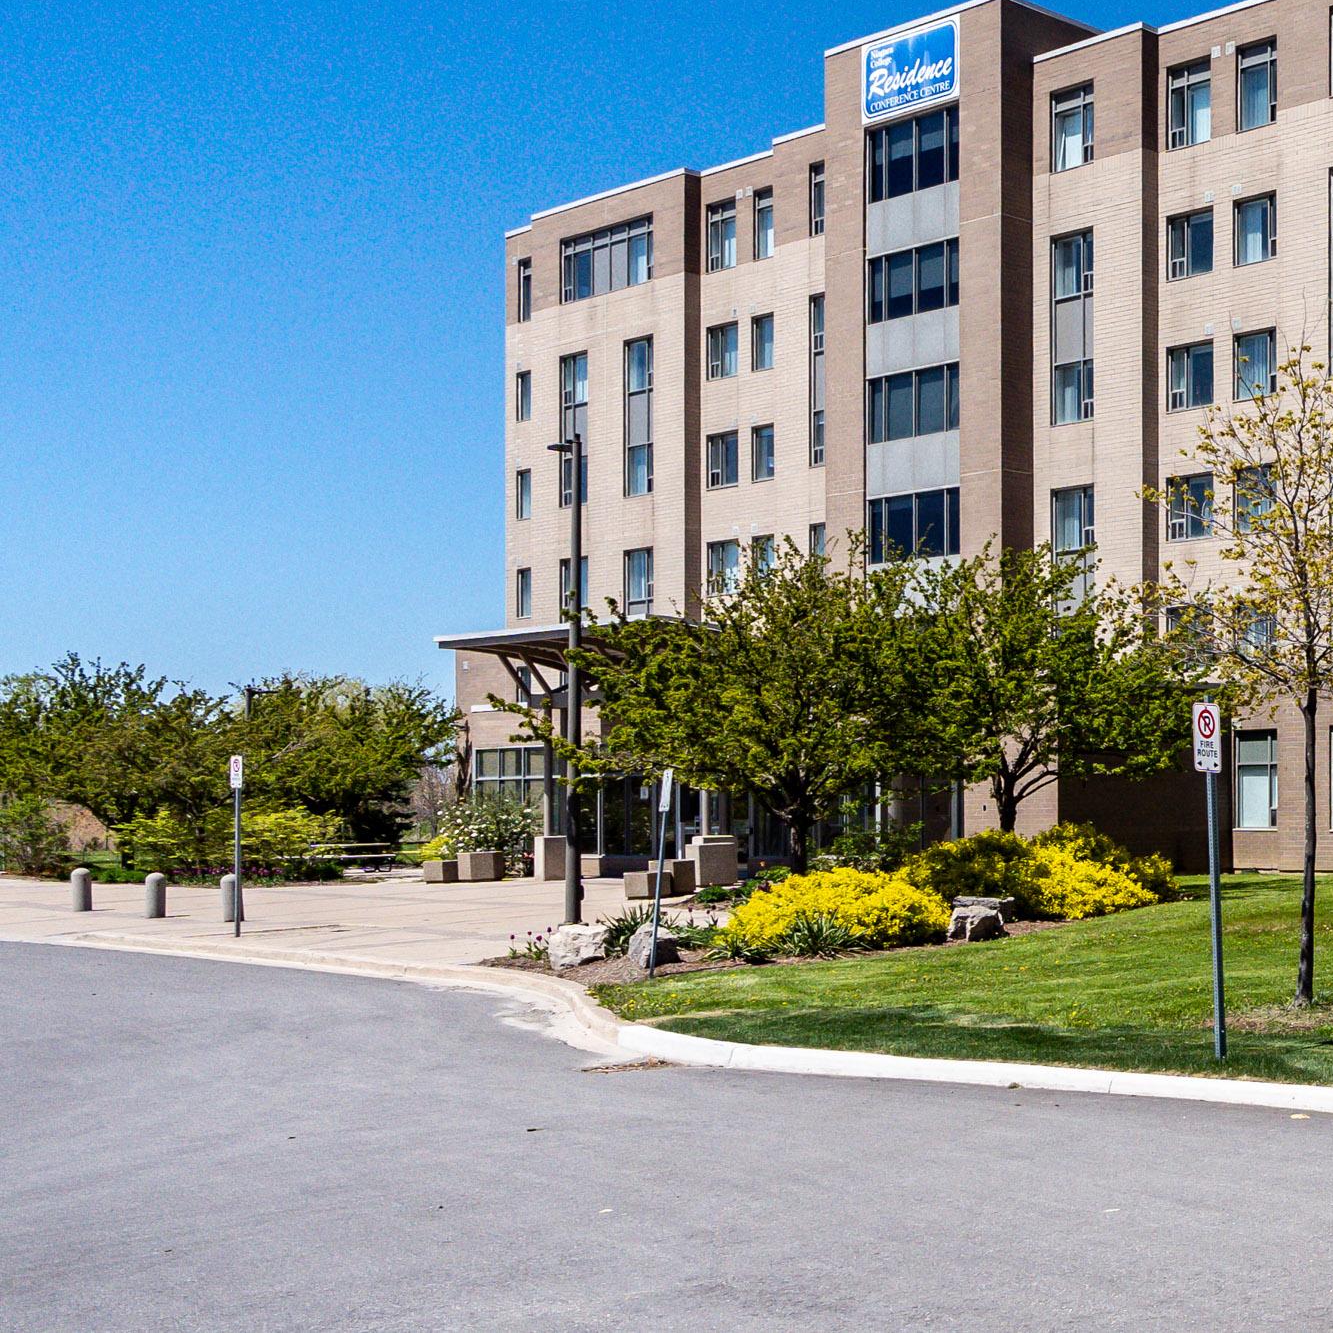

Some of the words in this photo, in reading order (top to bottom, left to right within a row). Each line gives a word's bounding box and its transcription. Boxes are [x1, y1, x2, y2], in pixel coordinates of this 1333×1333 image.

[868, 57, 953, 100] Residence
[870, 89, 920, 112] CONFERENCE
[919, 80, 951, 97] CENTRE
[1197, 748, 1218, 758] ROUTE
[1200, 740, 1214, 749] FIRE
